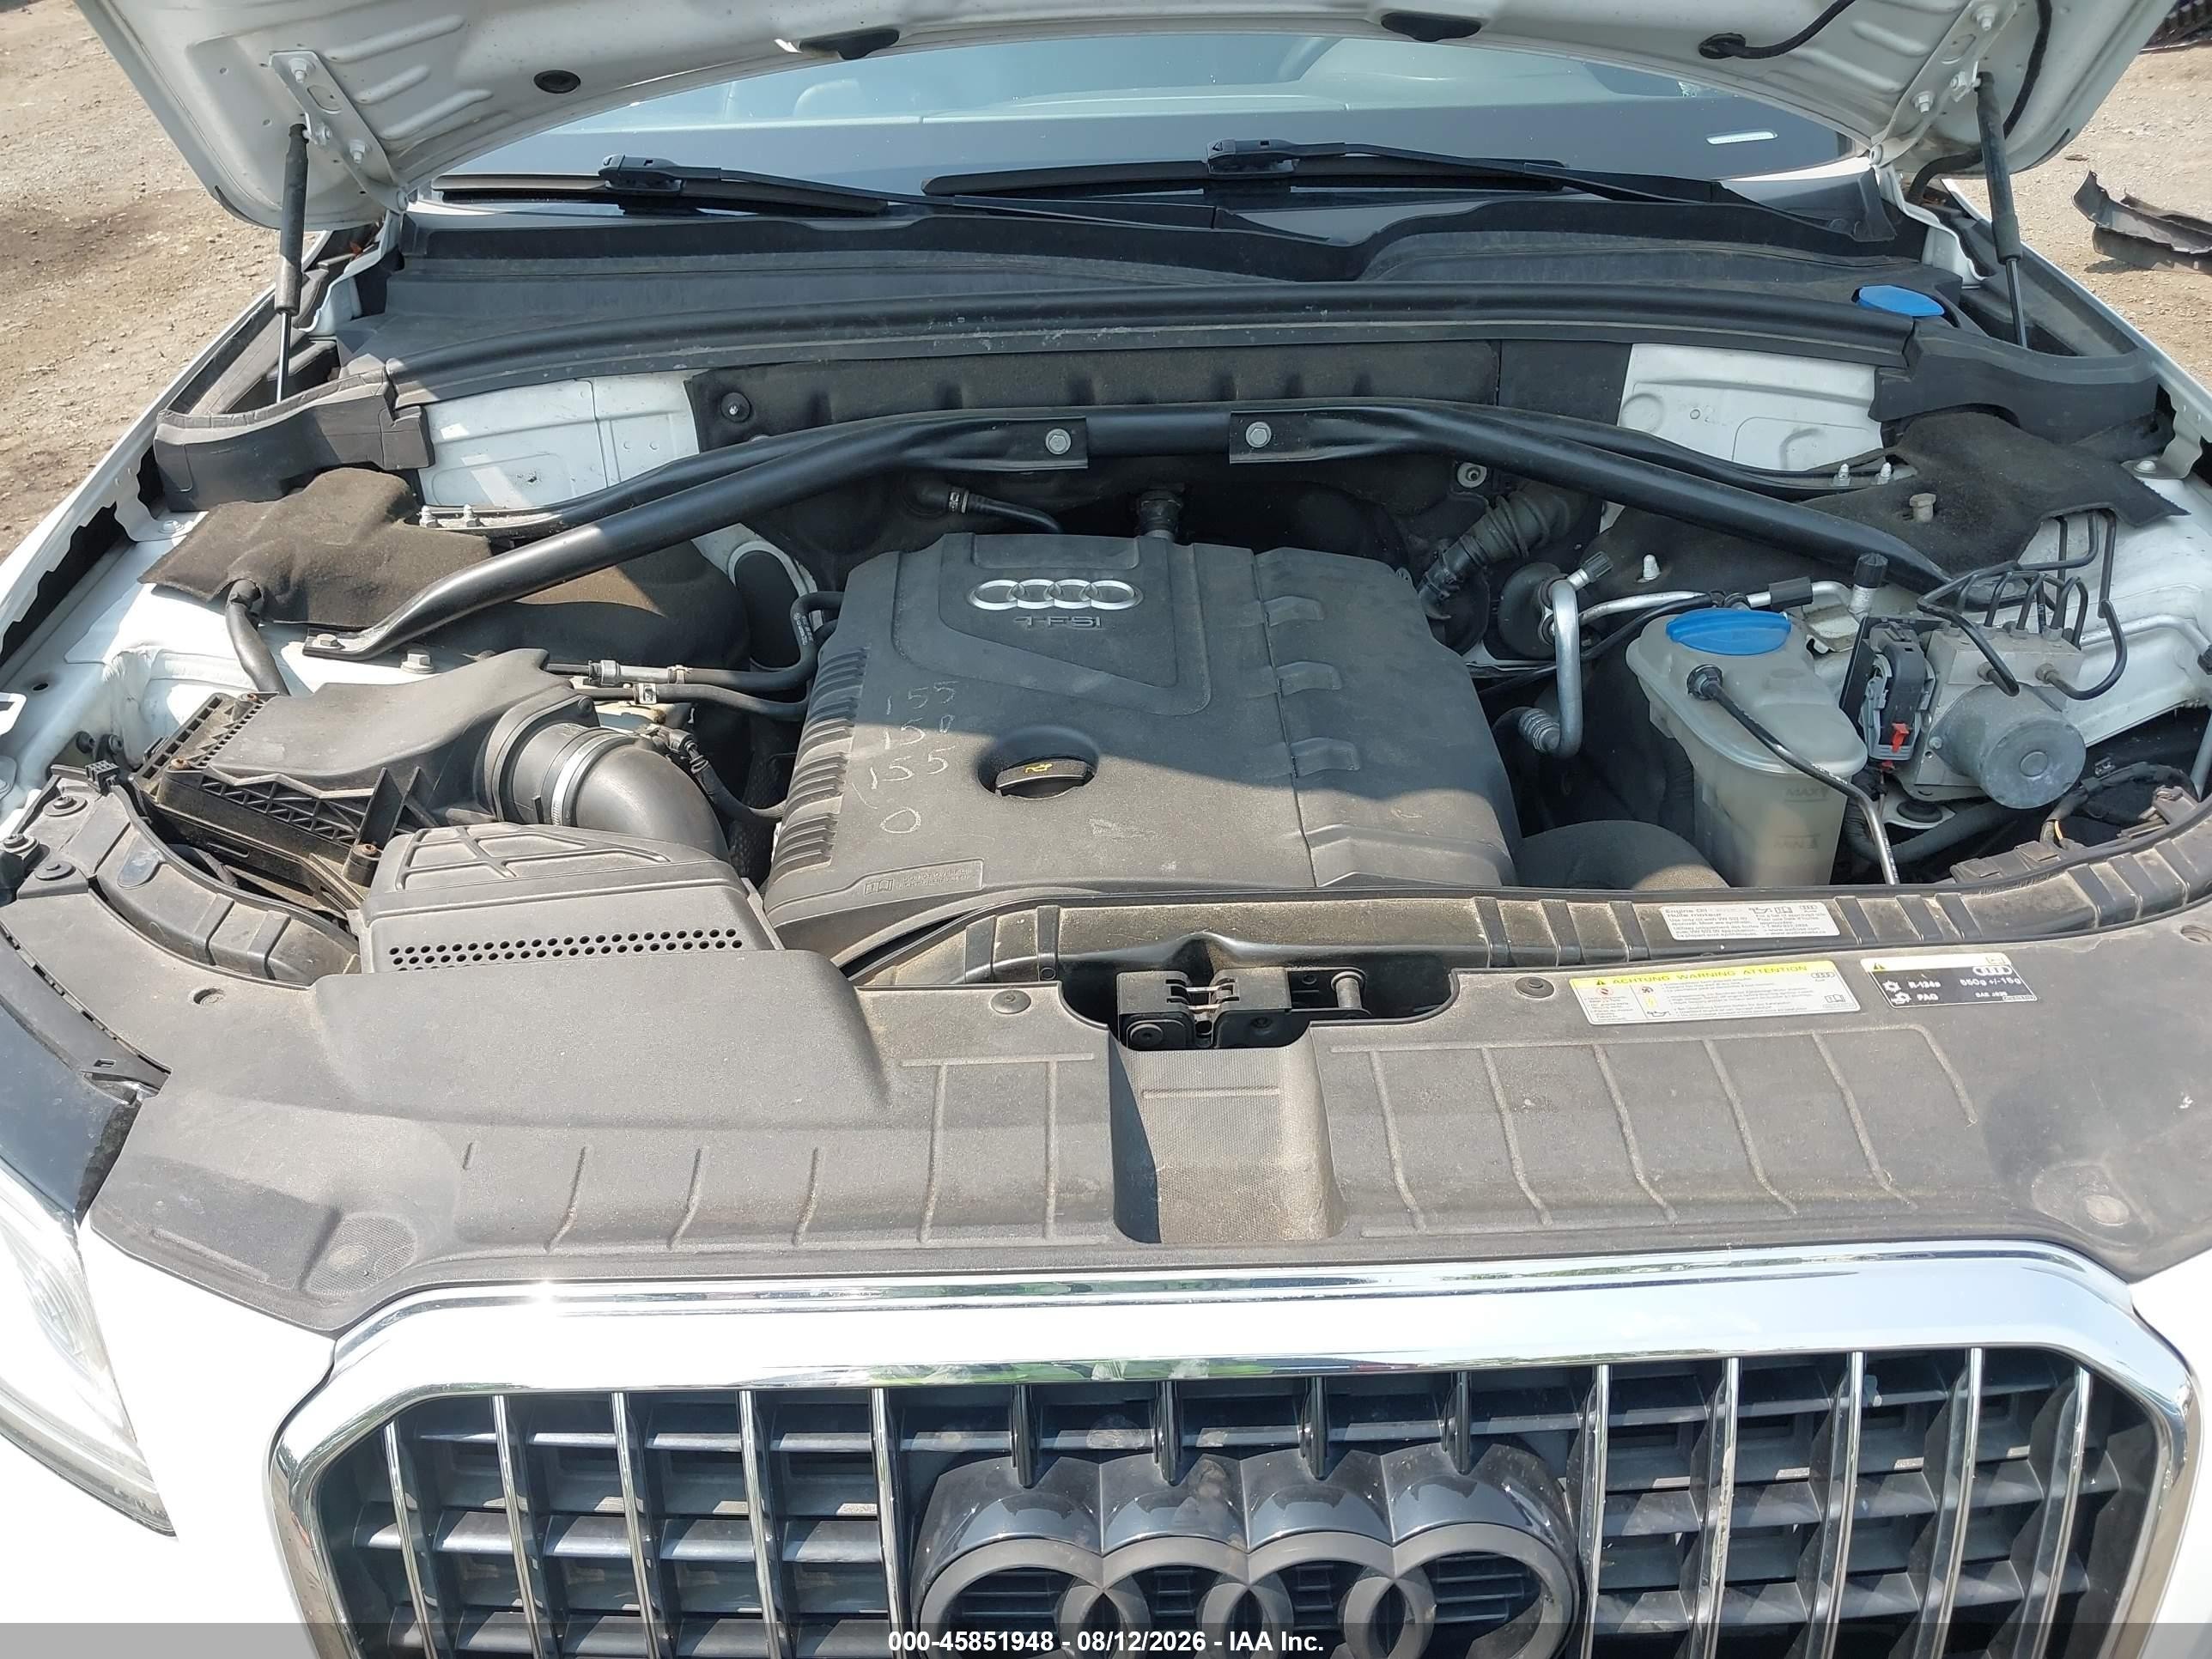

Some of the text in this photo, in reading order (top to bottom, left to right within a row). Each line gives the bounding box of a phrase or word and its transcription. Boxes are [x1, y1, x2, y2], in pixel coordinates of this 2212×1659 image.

[869, 745, 956, 789] 155
[1613, 975, 1670, 984] ACHTUNG
[1676, 970, 1735, 980] WARNING
[1743, 965, 1808, 975] ATTENTION
